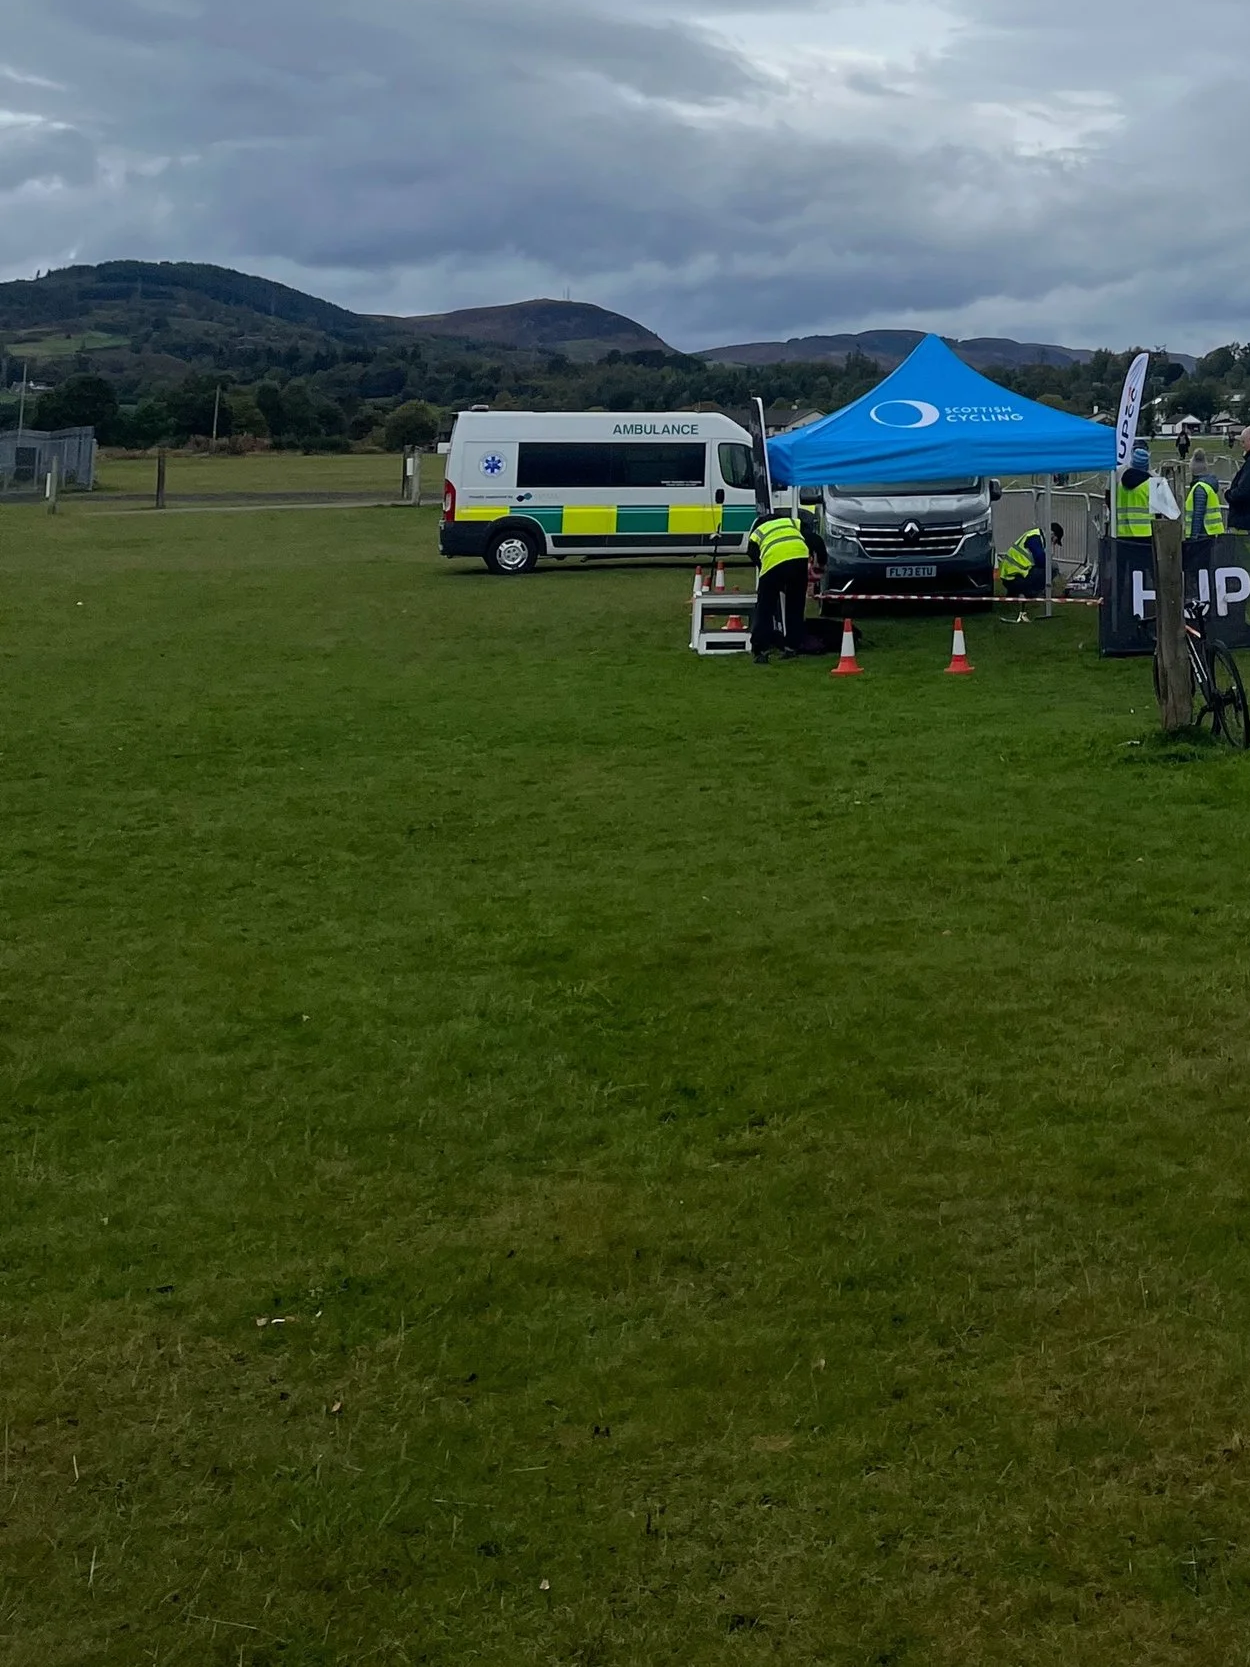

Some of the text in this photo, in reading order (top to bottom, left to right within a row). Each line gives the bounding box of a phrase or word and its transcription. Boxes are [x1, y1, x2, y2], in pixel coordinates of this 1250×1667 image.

[944, 406, 1012, 414] SCOTTISH
[946, 413, 1024, 422] CYCLING
[613, 424, 699, 435] AMBULANCE
[1117, 388, 1137, 466] UPcc
[890, 567, 933, 576] FL73 ETU
